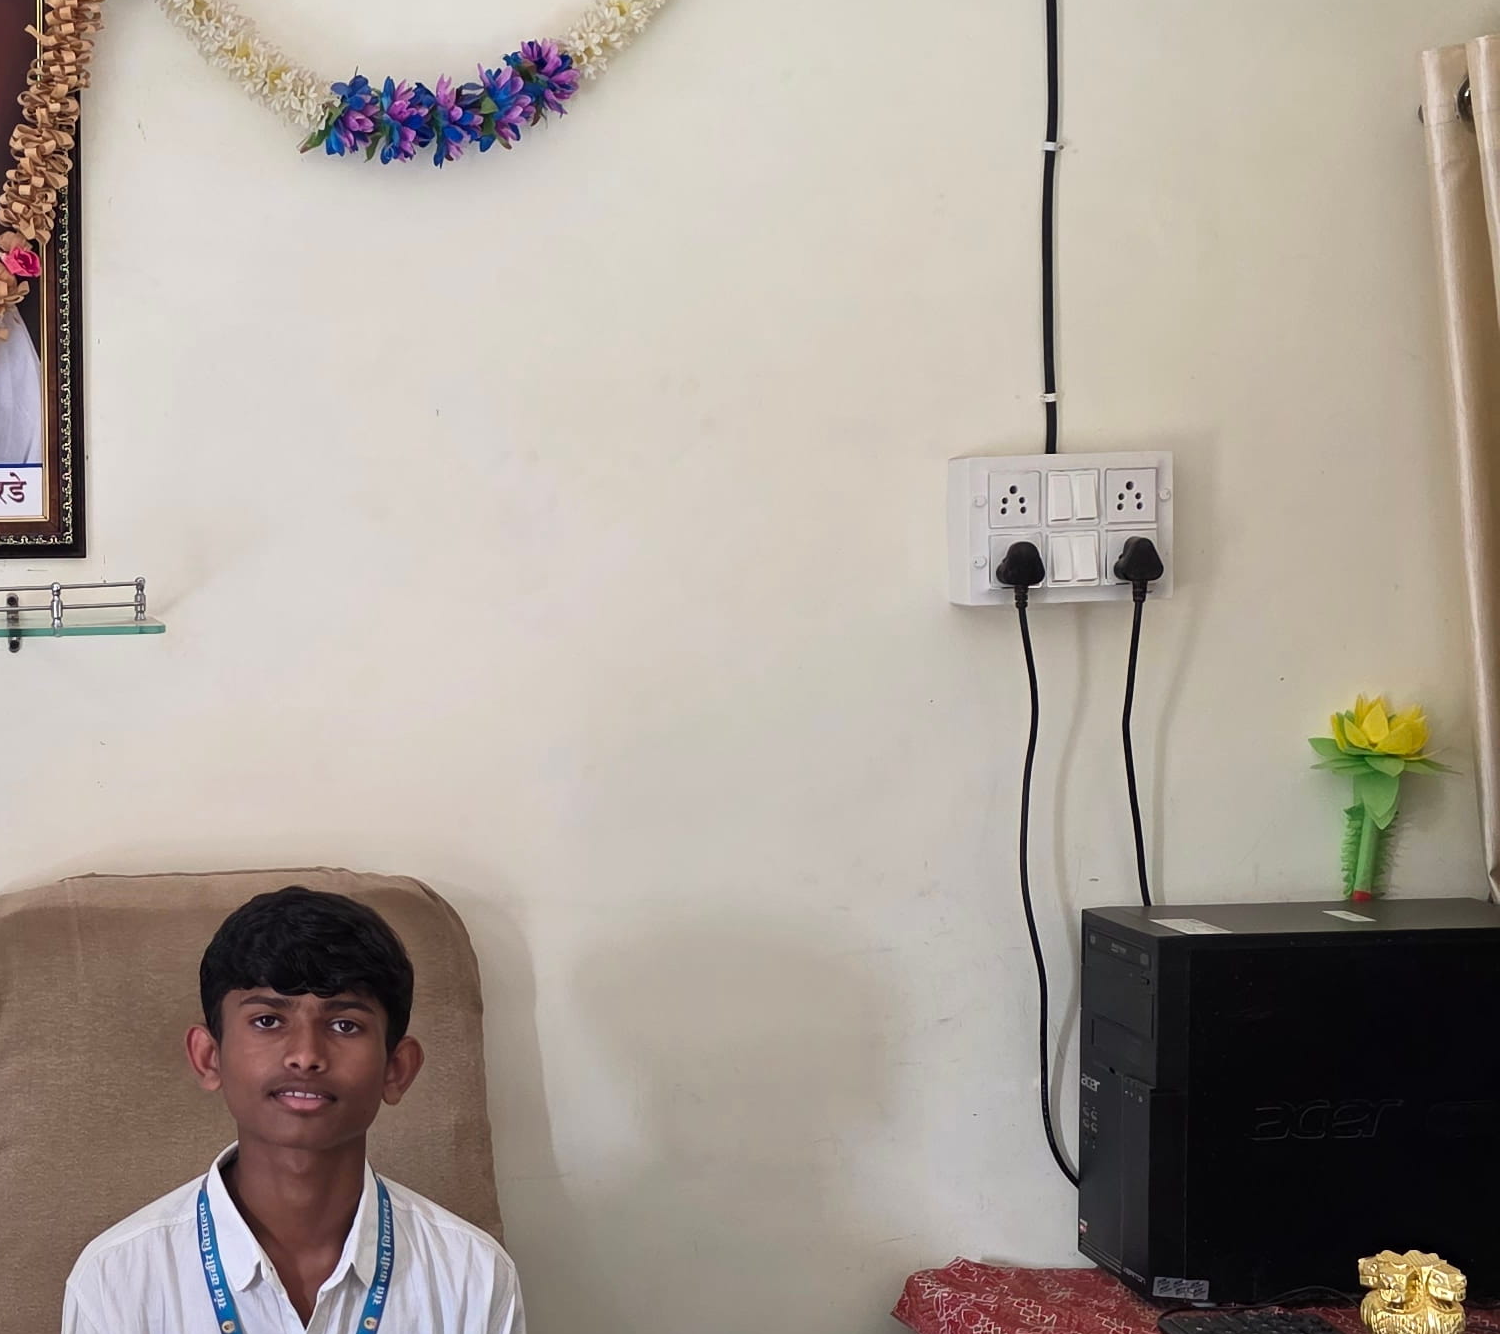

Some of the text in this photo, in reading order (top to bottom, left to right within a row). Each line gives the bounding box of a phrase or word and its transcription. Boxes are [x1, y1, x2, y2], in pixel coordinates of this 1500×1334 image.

[1081, 1073, 1100, 1091] acer
[1250, 1099, 1404, 1140] acer
[199, 1202, 212, 1252] विद्यालय
[214, 1289, 227, 1310] संत
[372, 1285, 385, 1306] संत
